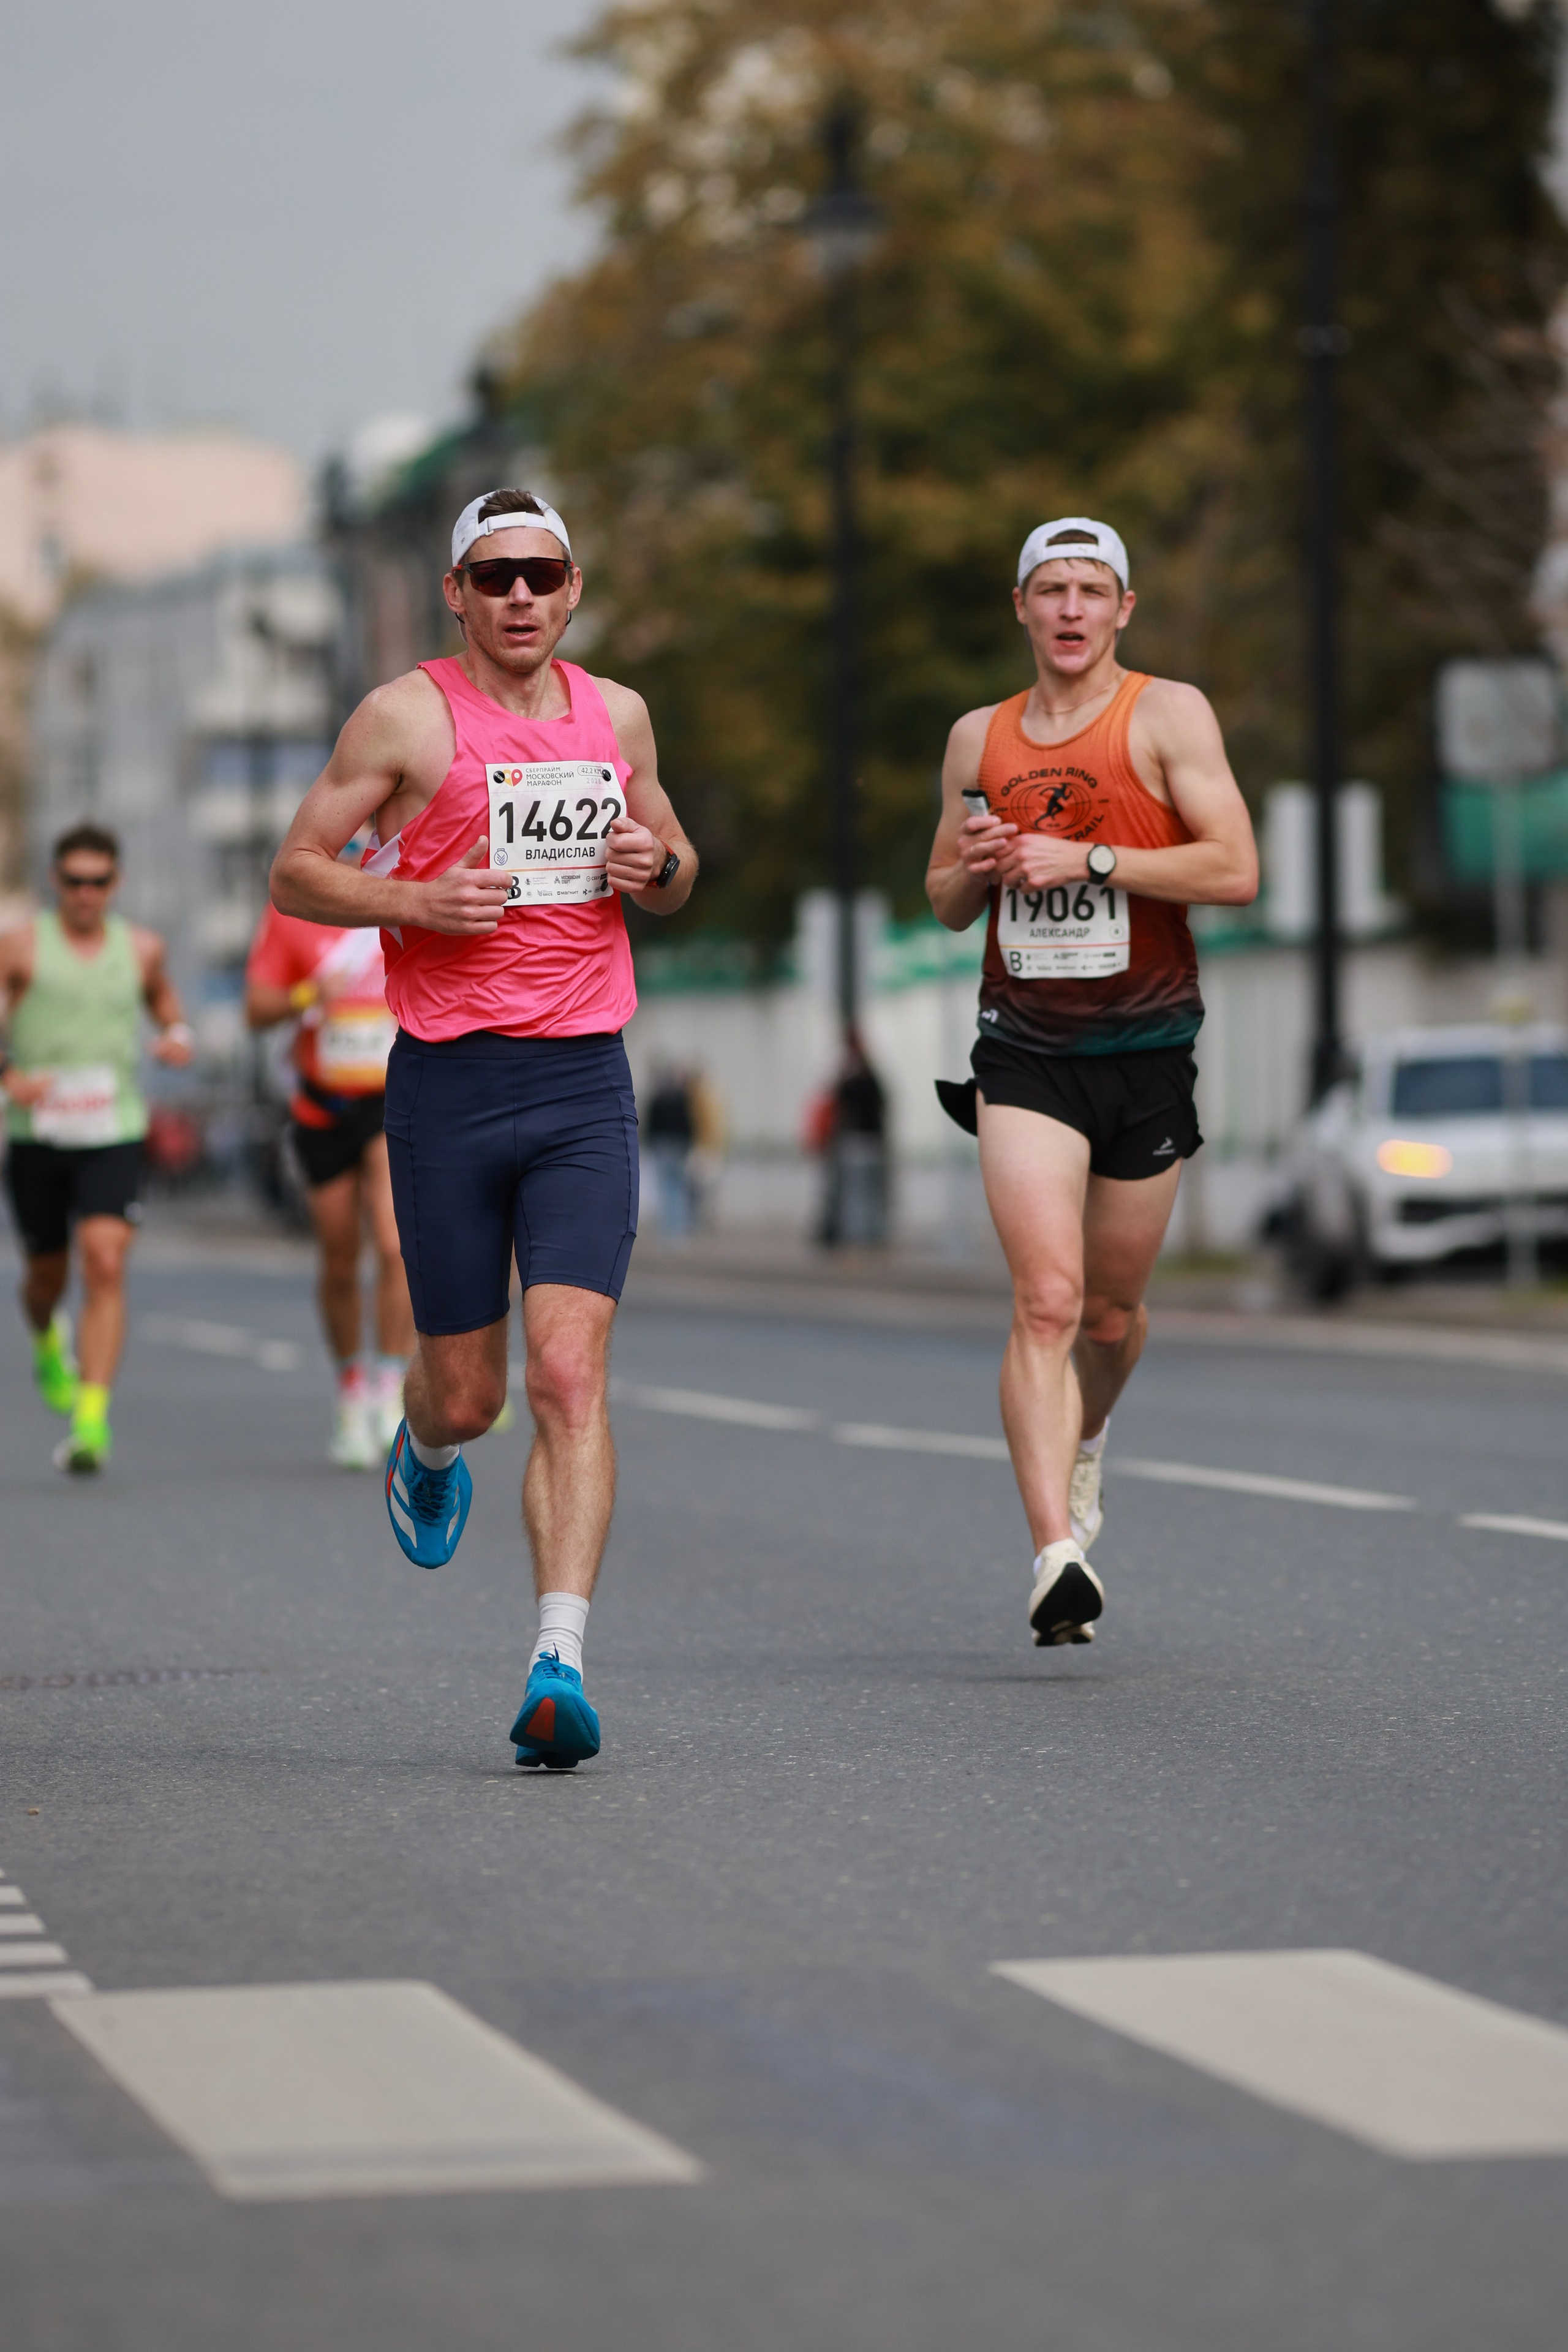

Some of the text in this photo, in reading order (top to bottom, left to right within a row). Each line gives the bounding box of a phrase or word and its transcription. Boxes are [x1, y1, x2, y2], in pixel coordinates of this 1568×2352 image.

[526, 771, 574, 780] МОСКОВСКИЙ
[1001, 767, 1098, 796] GOLDEN RING
[499, 797, 621, 843] 14622
[526, 847, 595, 861] ВЛАДИСЛАВ
[1006, 884, 1115, 922] 19061
[1030, 927, 1090, 938] АЛЕКСАНДР
